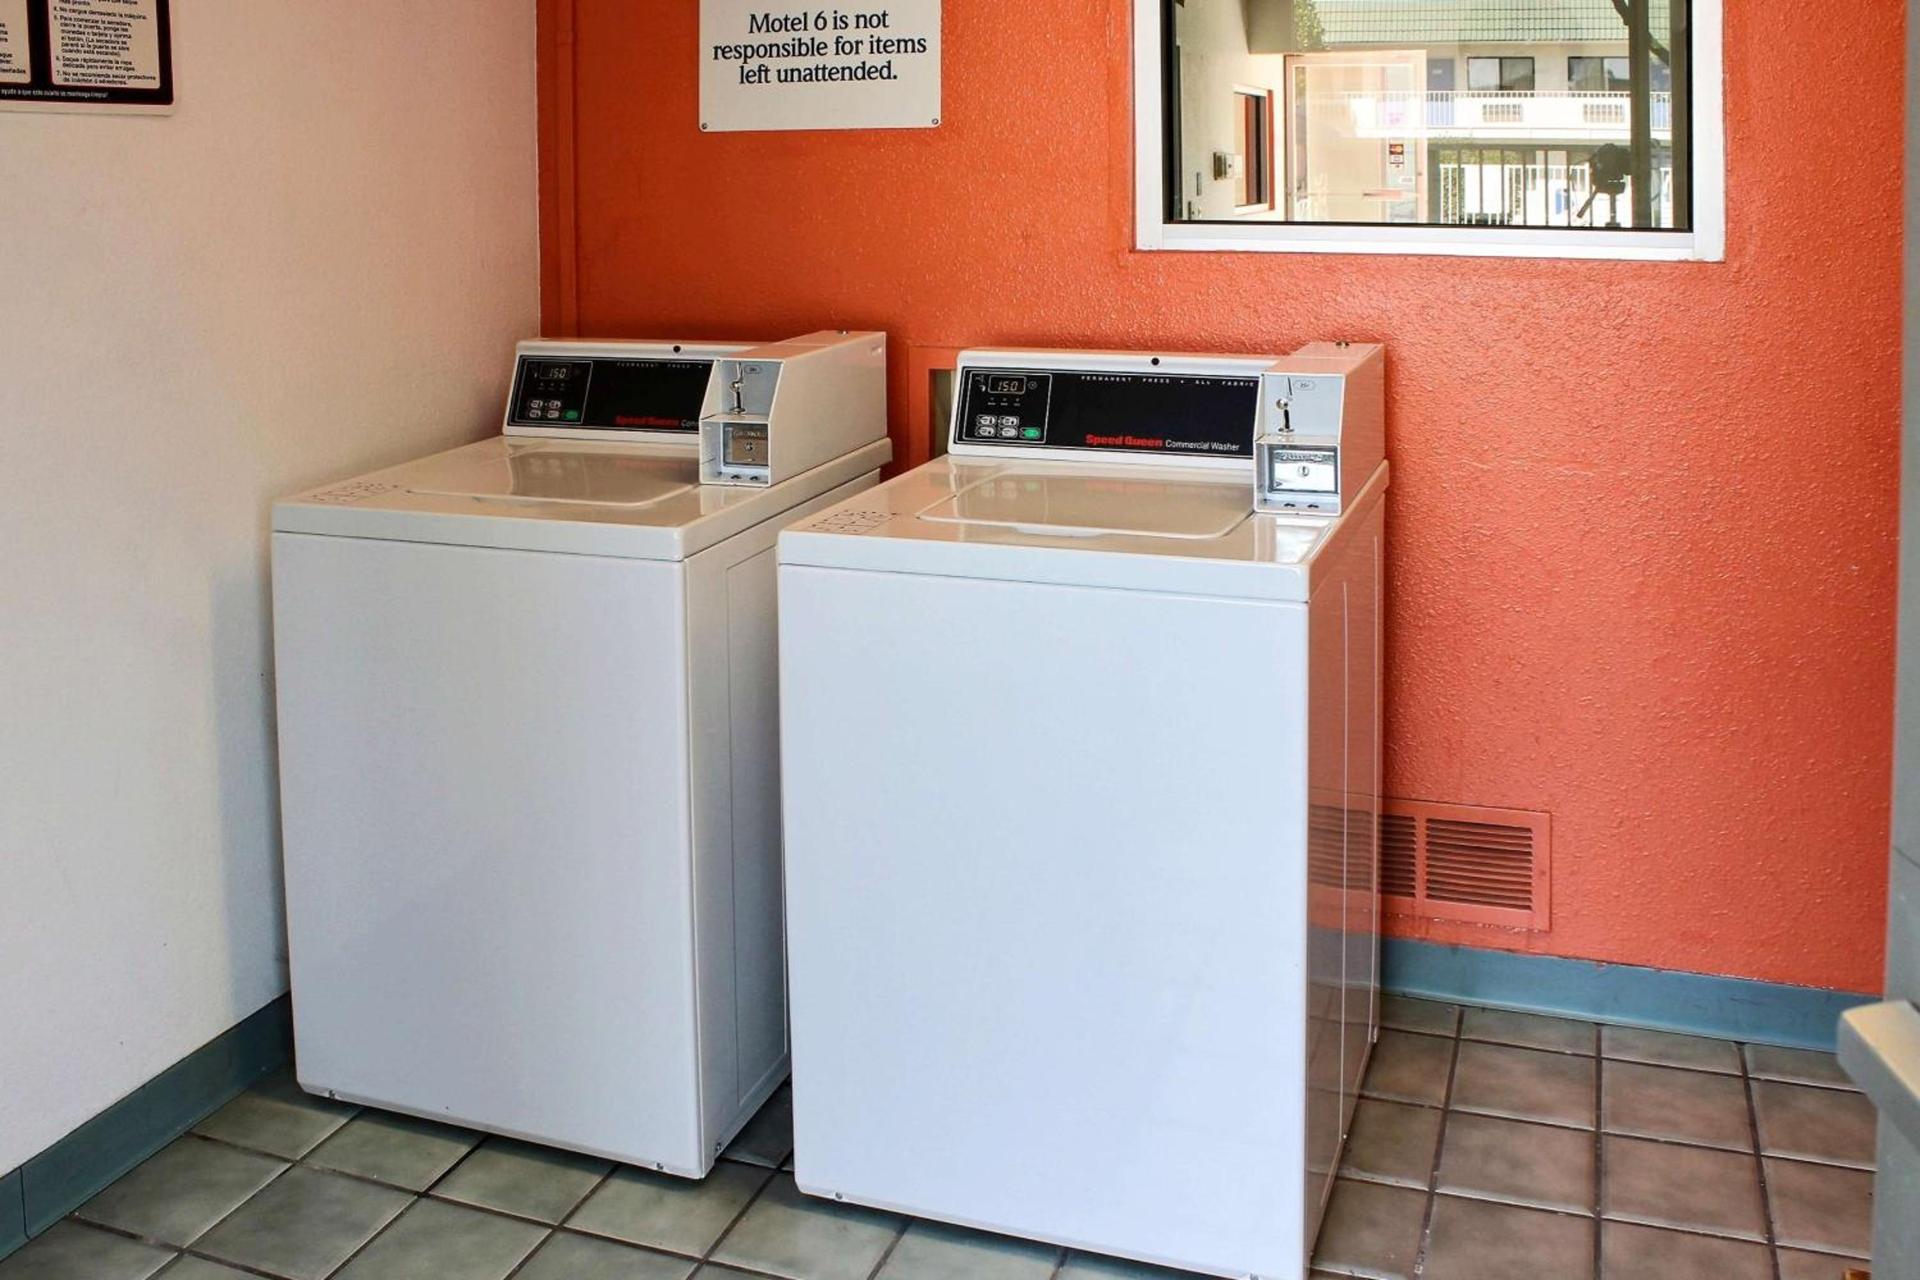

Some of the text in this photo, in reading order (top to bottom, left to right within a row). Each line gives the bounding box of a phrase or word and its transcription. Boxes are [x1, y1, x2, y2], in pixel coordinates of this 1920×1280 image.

[748, 10, 889, 34] Motel 6 is not
[712, 35, 927, 64] responsible for items
[739, 60, 898, 84] left unattended.
[1081, 375, 1133, 383] PERMANENT
[1086, 433, 1240, 452] Speed Queen Commercial Washer
